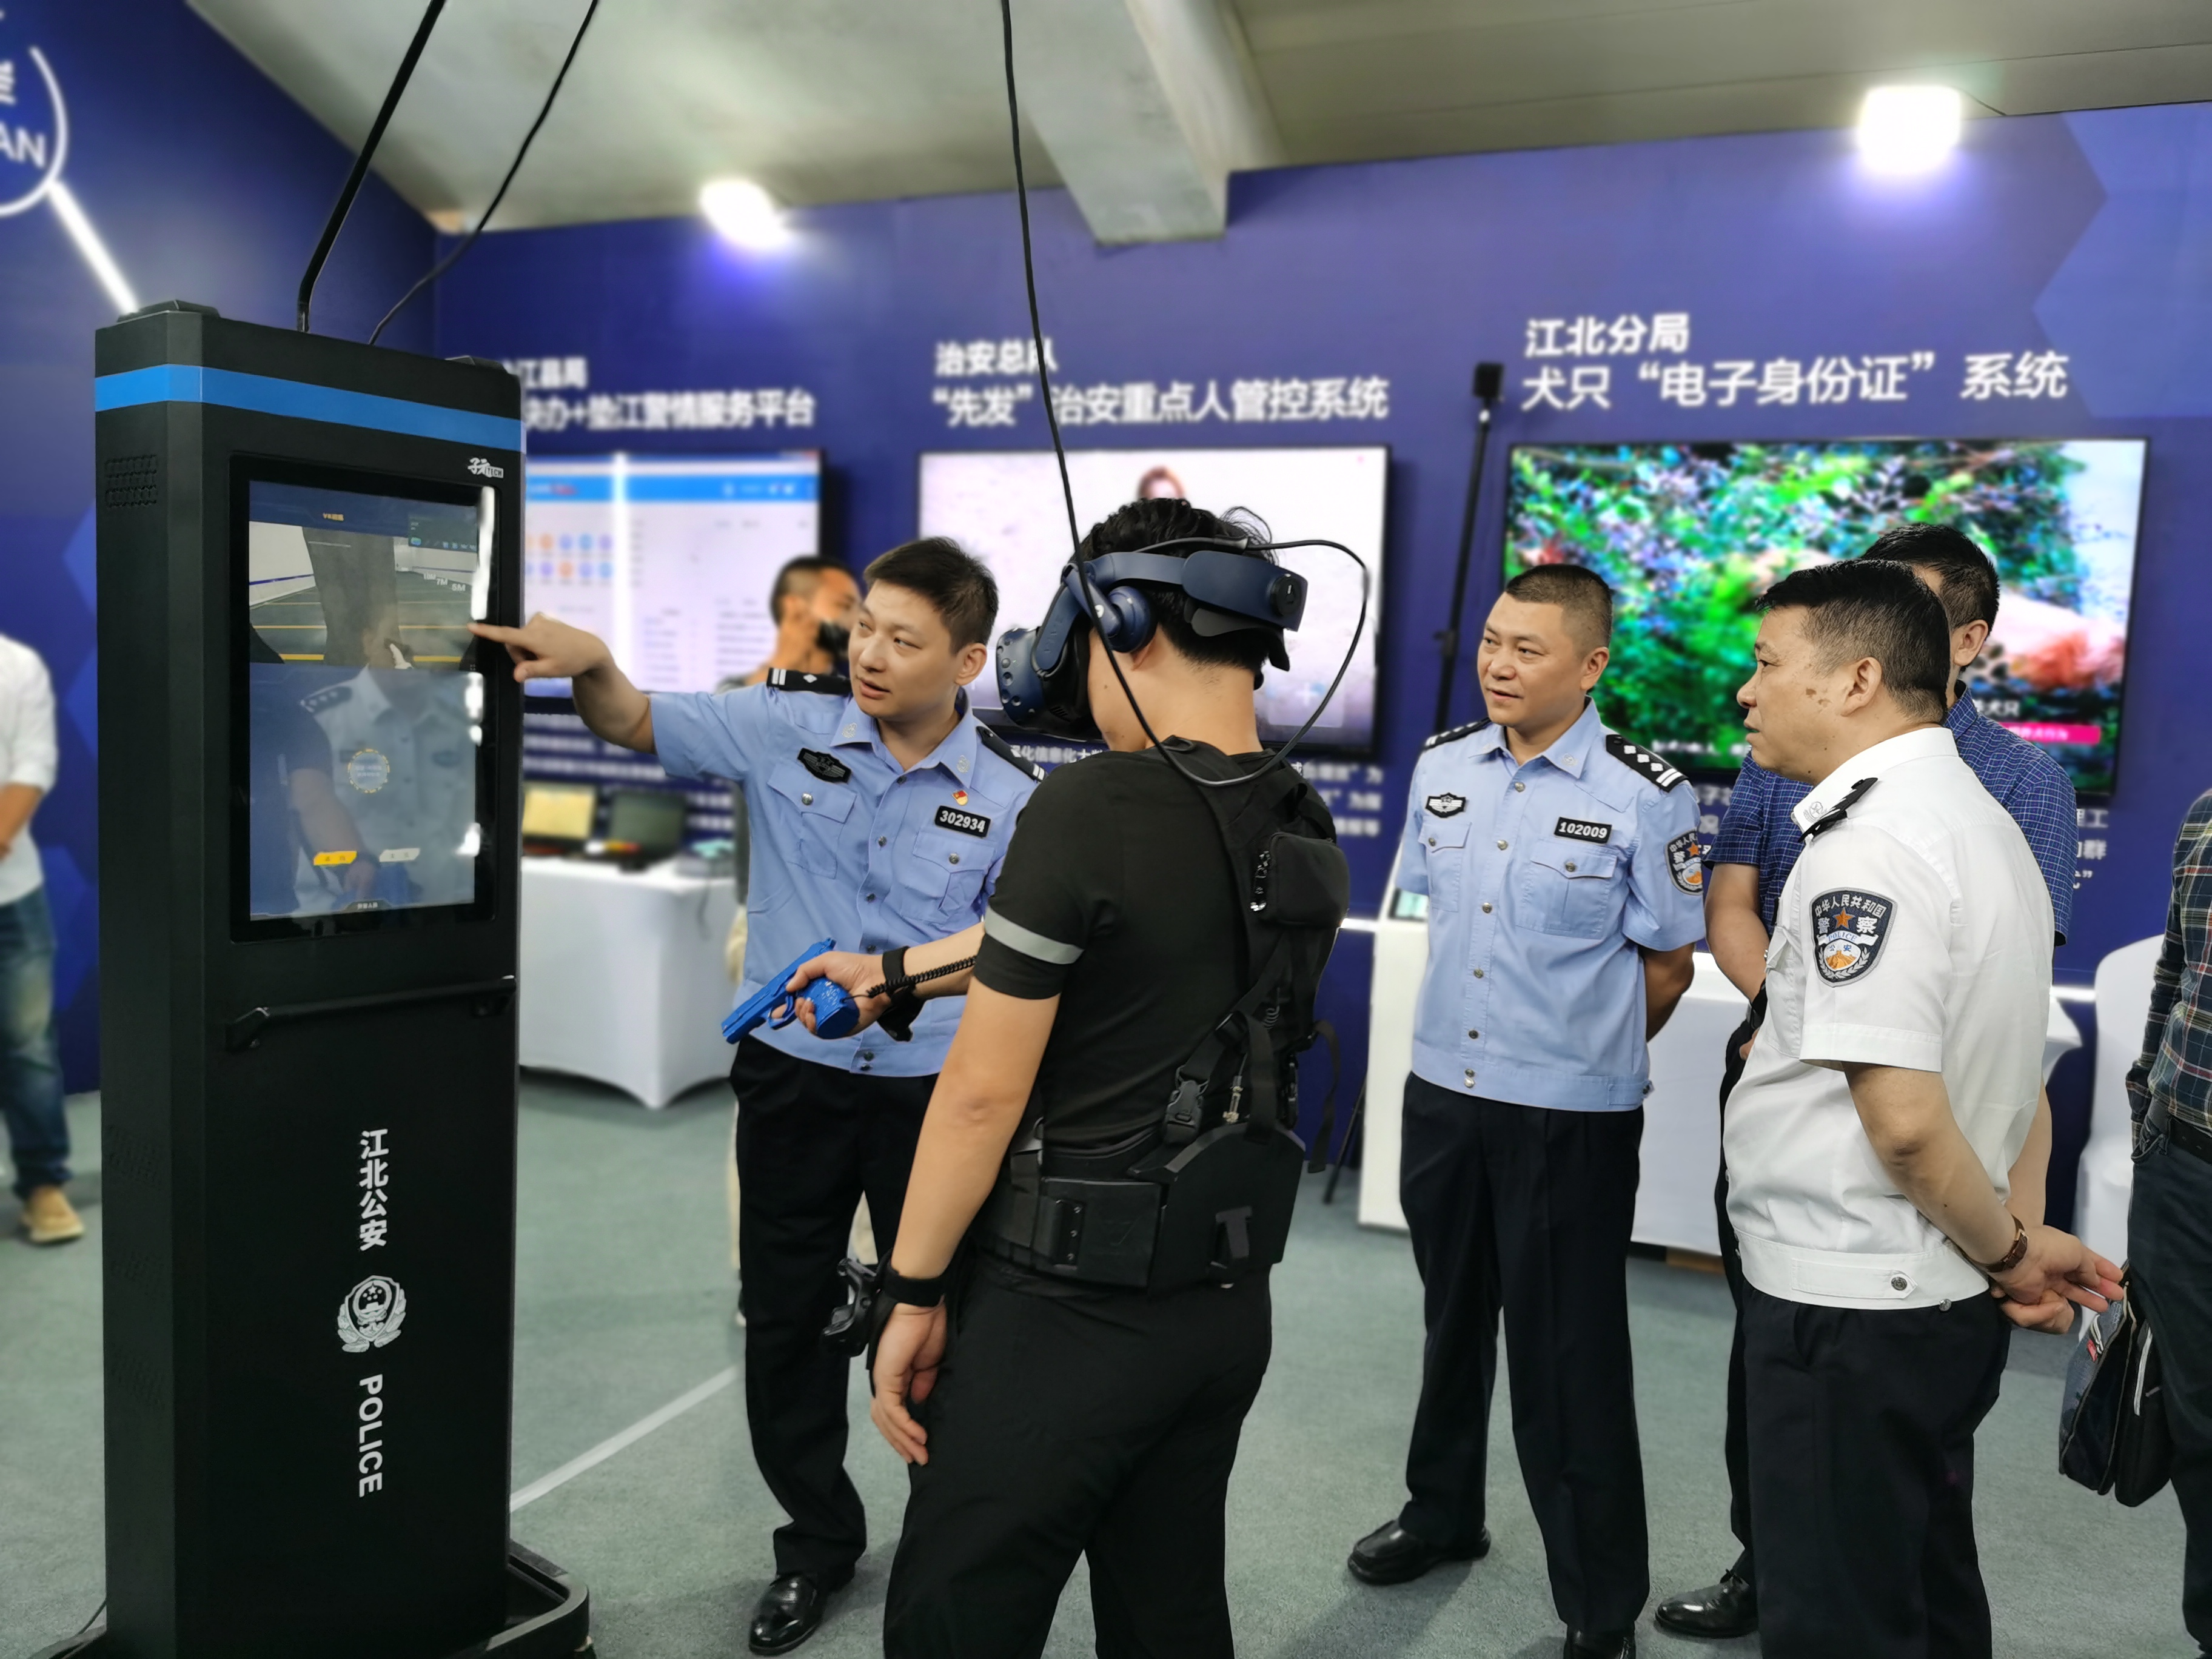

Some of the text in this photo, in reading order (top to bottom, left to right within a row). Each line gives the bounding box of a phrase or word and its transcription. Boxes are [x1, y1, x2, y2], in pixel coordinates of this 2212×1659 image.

[1523, 312, 1691, 358] 江北分局
[934, 338, 1059, 377] 治安总队
[939, 810, 986, 833] 302934
[1558, 822, 1607, 839] 102009
[2076, 839, 2107, 860] 群
[1814, 894, 1888, 919] 中华人民共和国
[1827, 930, 1858, 942] POLICE
[358, 1128, 389, 1252] 江北公安
[358, 1373, 383, 1498] POLICE
